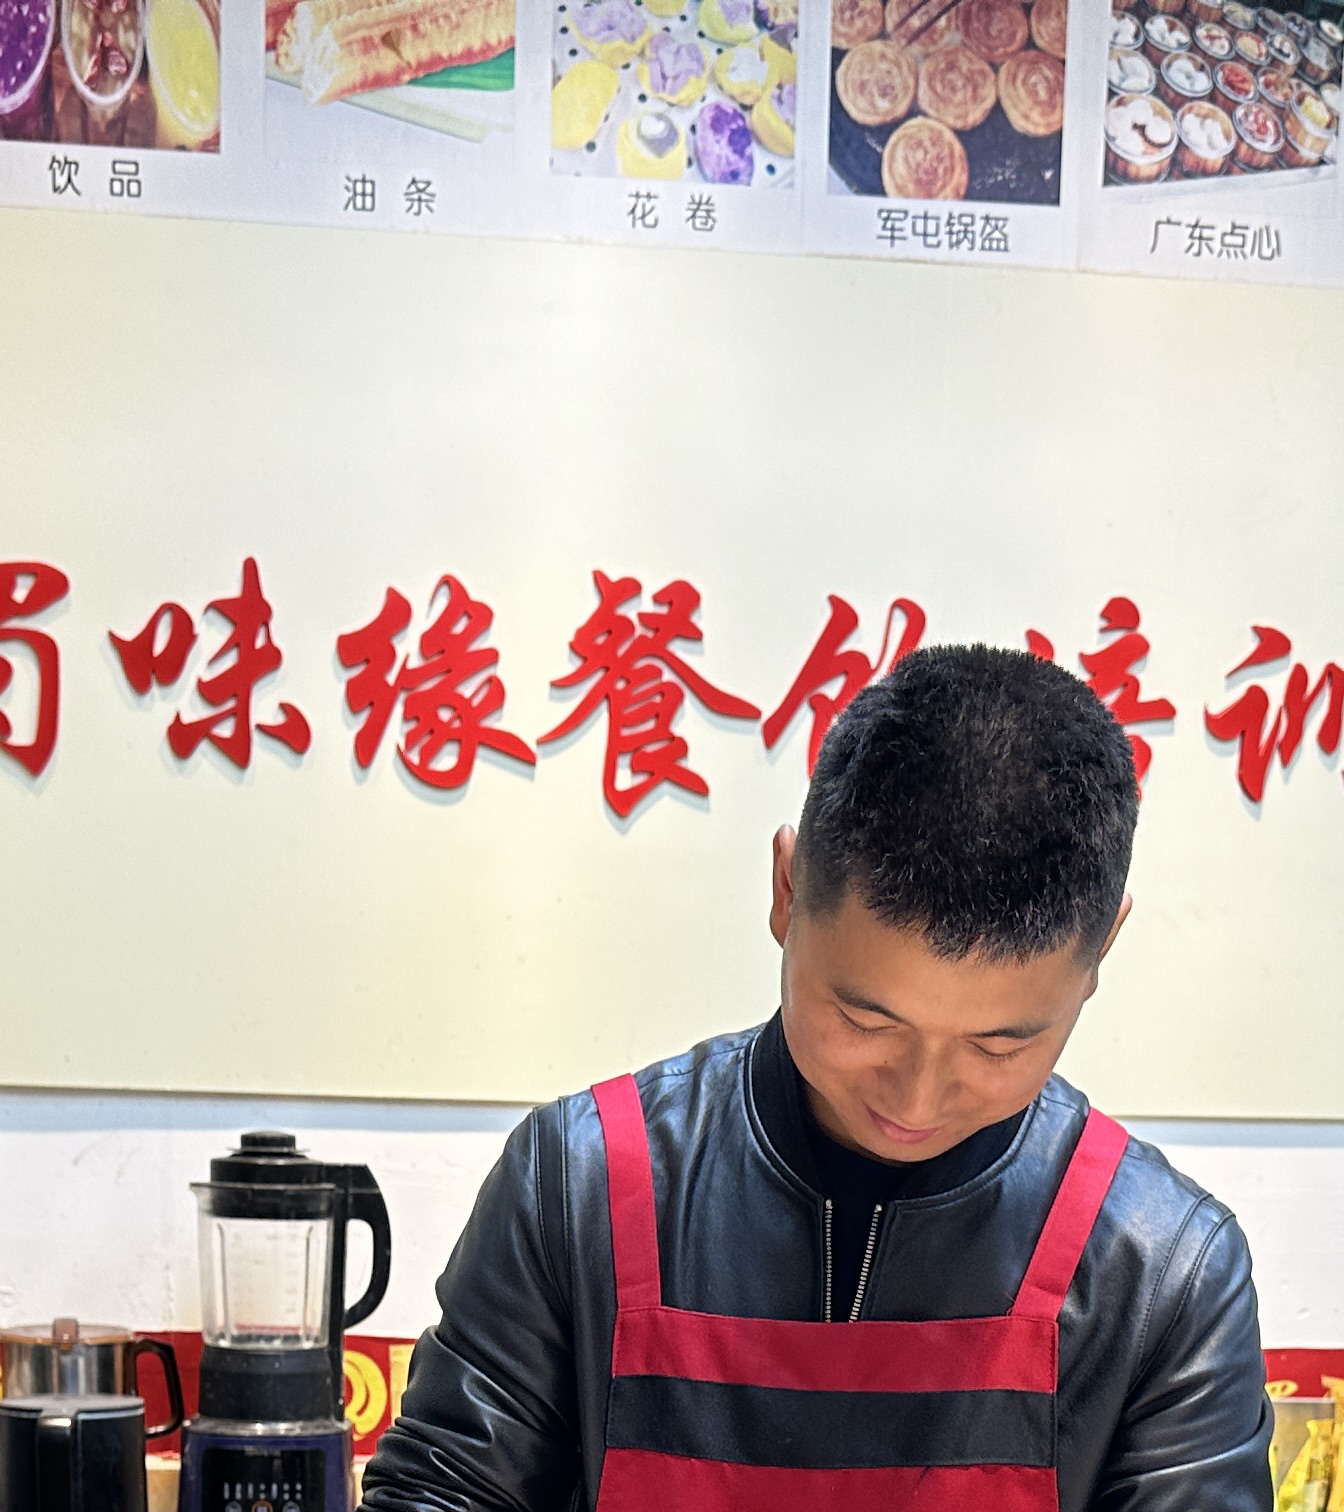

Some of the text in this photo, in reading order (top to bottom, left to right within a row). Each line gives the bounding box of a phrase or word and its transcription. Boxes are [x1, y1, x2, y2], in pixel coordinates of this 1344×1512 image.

[47, 154, 142, 199] 饮品
[343, 173, 436, 217] 油条
[627, 191, 718, 232] 花卷
[875, 207, 1010, 253] 军屯锅盔
[1149, 216, 1283, 262] 广东点心
